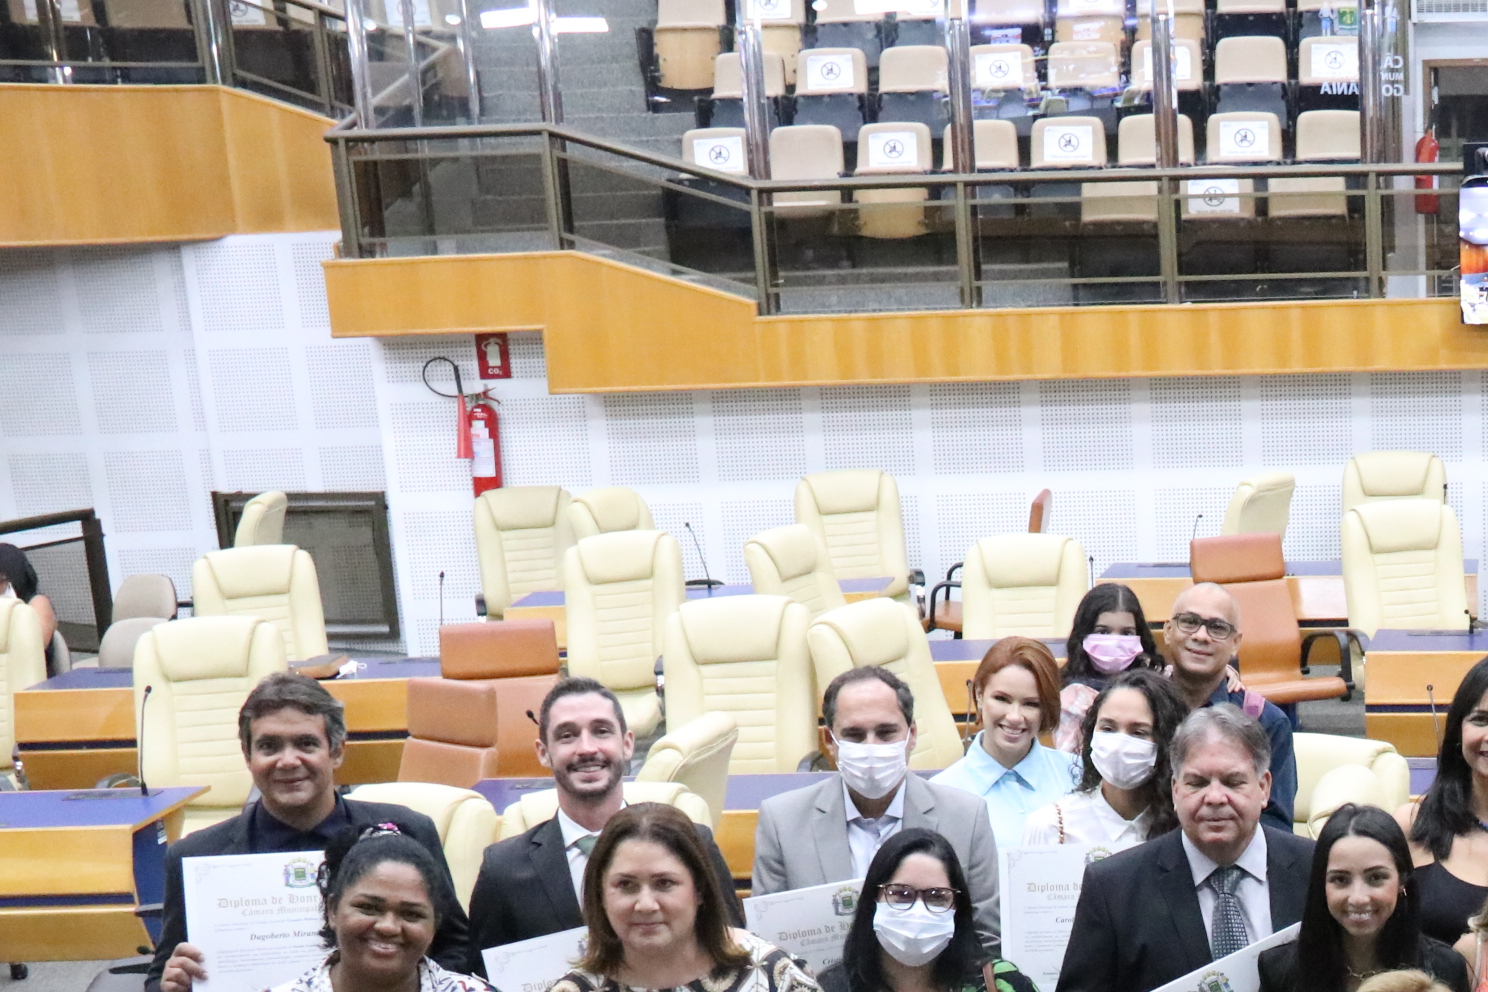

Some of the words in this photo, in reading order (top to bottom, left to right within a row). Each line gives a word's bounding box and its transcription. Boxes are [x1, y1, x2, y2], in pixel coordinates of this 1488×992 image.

[1026, 882, 1070, 893] Diploma
[217, 897, 267, 909] Diploma
[778, 927, 822, 941] Diploma
